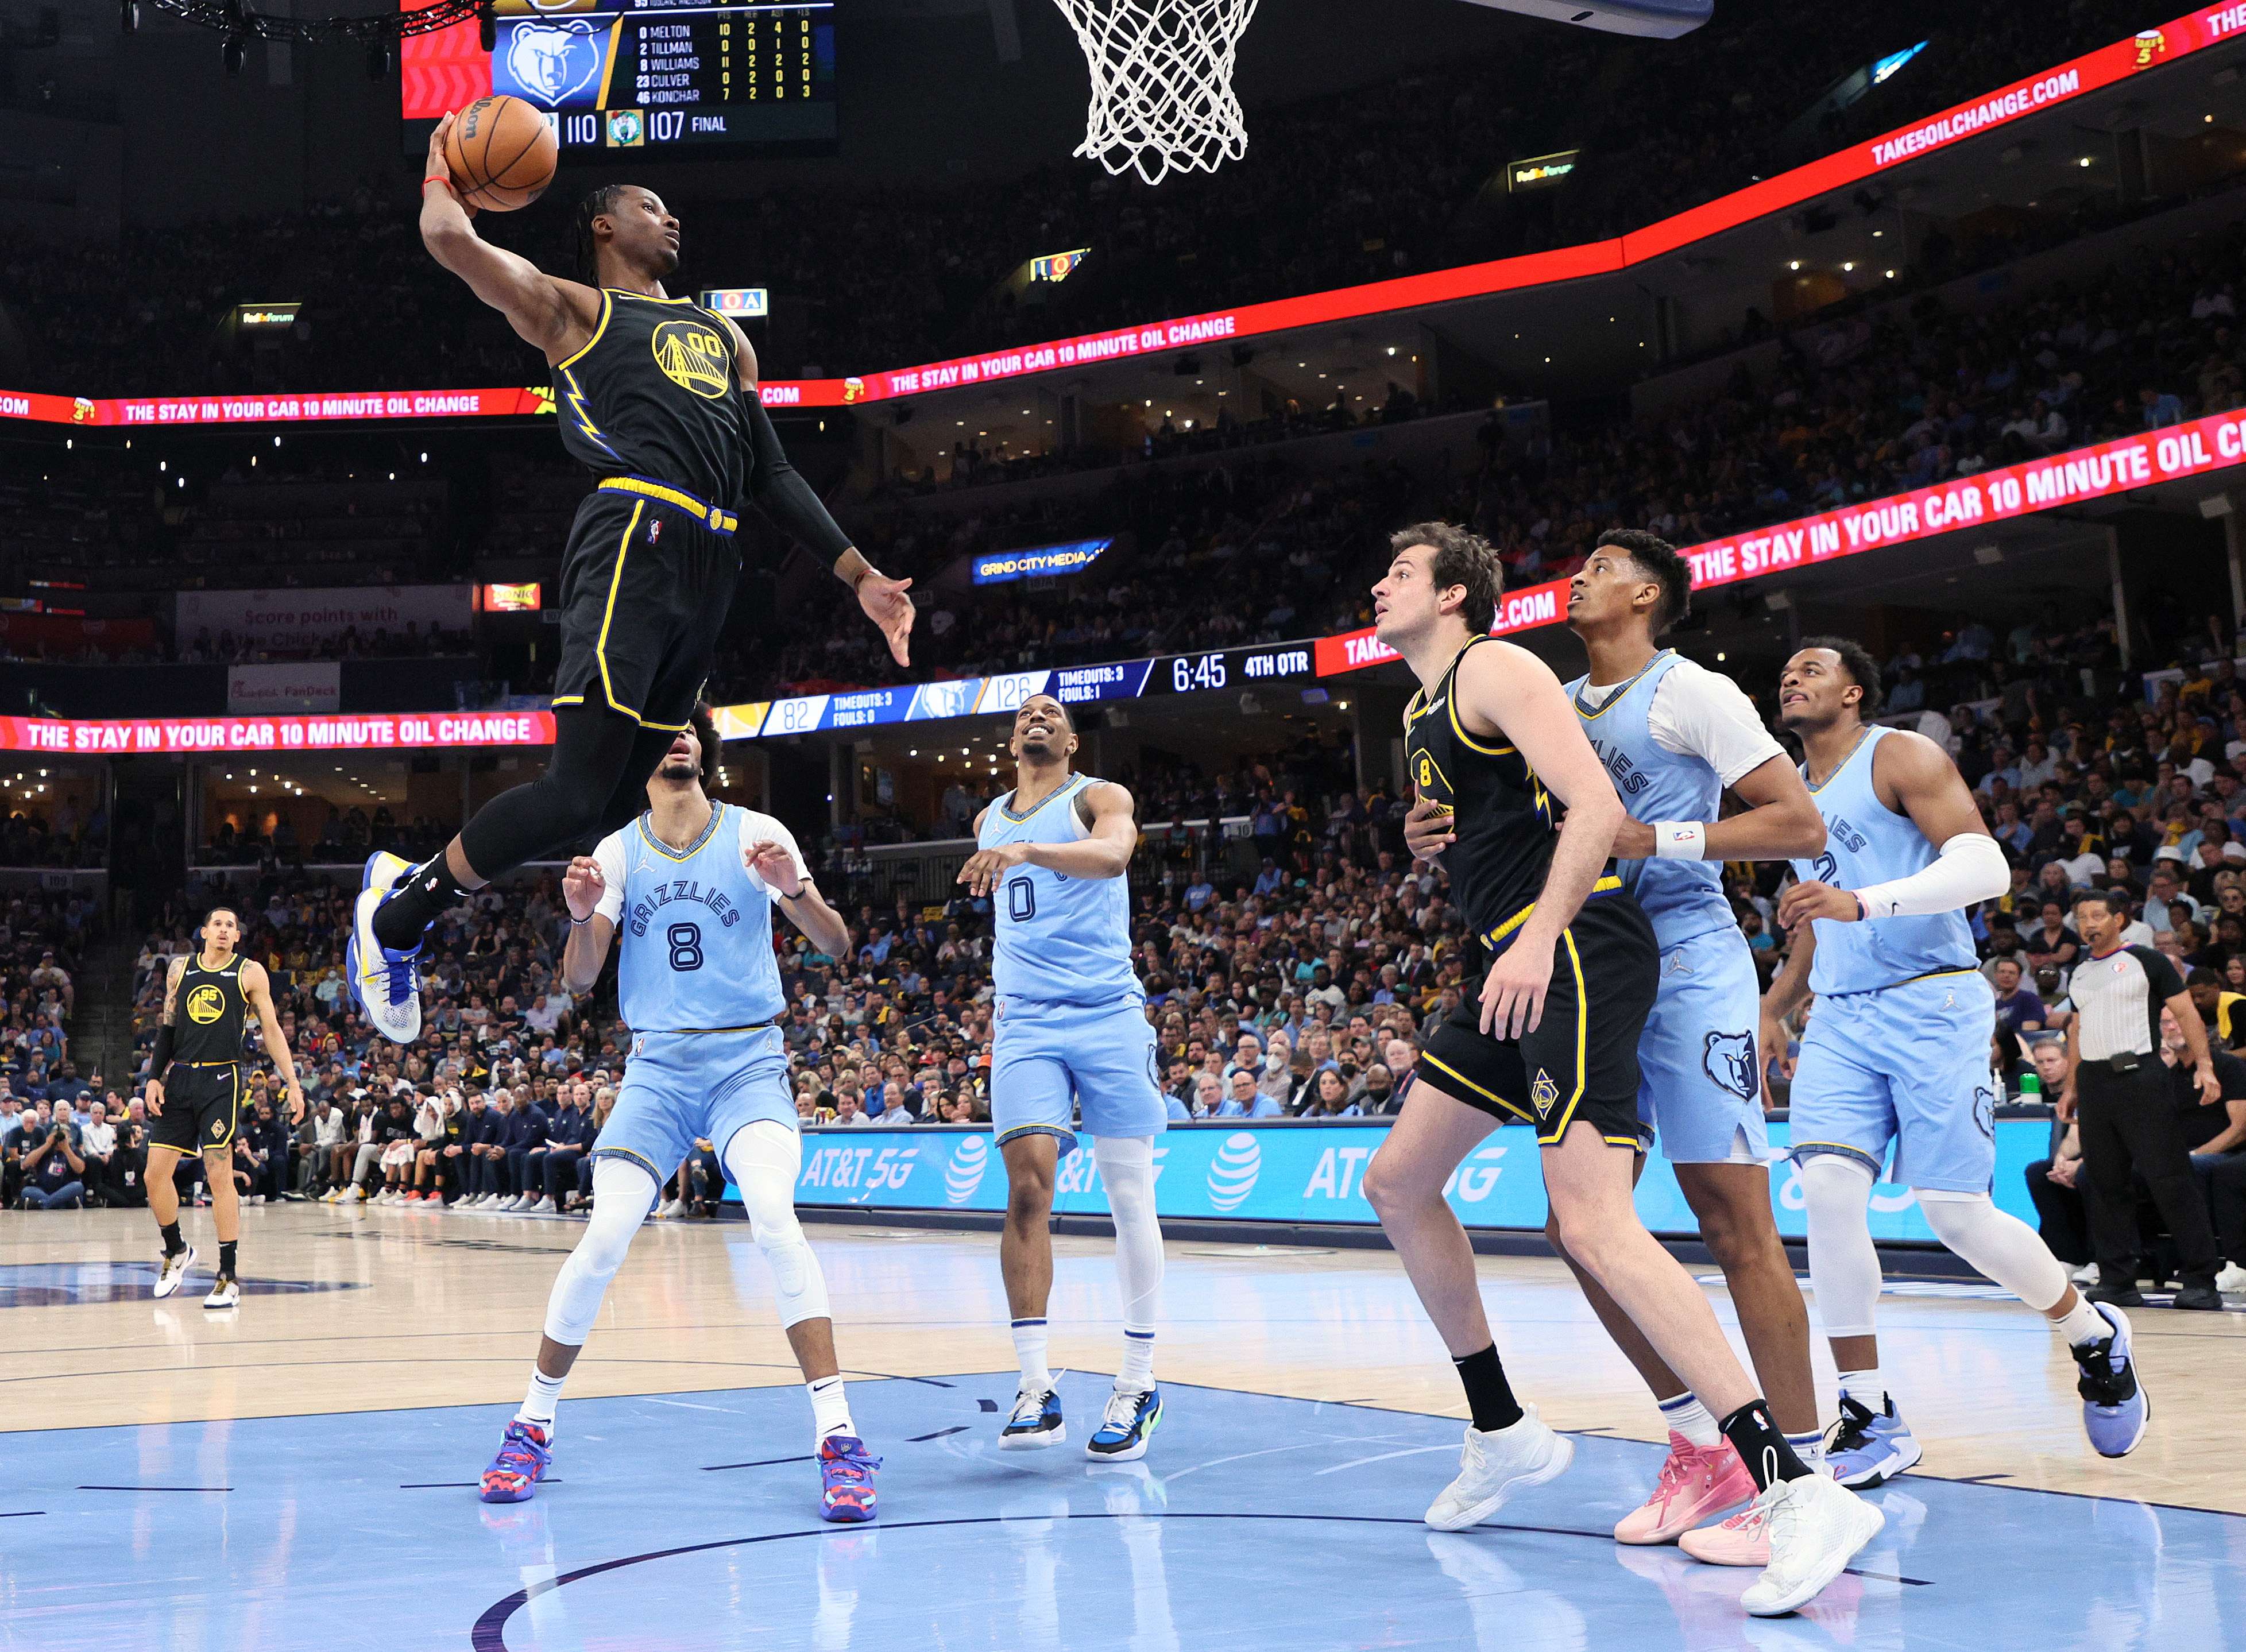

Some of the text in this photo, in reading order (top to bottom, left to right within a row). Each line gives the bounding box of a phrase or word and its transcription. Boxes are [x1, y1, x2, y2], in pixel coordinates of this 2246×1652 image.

[639, 20, 809, 39] 0 MELTON 10 2 4 0
[2207, 3, 2246, 36] THE
[640, 42, 647, 55] 2
[651, 41, 693, 54] TILLMAN
[721, 40, 729, 52] 0
[748, 38, 756, 51] 0
[802, 36, 809, 49] 0
[640, 59, 648, 71] 8
[651, 57, 699, 71] WILLIAMS
[748, 55, 756, 67] 2
[775, 53, 782, 66] 2
[802, 52, 809, 65] 2
[636, 69, 810, 88] 23 CULVER 0 2 0 0
[636, 85, 810, 103] 46 KONCHAR 7 2 0 3
[567, 111, 726, 143] 110 107 FINAL
[1872, 68, 2078, 165] TAKE5OILCHANGE.COM
[710, 293, 761, 309] IOA
[687, 332, 721, 358] 00
[892, 316, 1234, 392] THE STAY IN YOUR CAR 10 MINUTE OIL CHANGE
[126, 396, 478, 420] THE STAY IN YOUR CAR 10 MINUTE OIL CHANGE
[1690, 547, 1736, 582] THE
[1741, 529, 1803, 571] STAY
[1810, 521, 1839, 555] IN
[1843, 503, 1918, 545] YOUR
[1925, 487, 1982, 527] CAR
[1989, 478, 2020, 511] 10
[2026, 446, 2150, 503] MINUTE
[2158, 432, 2211, 471] OIL
[980, 551, 1087, 576] GRIND CITY MEDIA
[245, 607, 397, 625] Score points with
[1058, 666, 1123, 687] TIMEOUTS: 3
[1173, 651, 1308, 692] 6:45 4TH QTR
[833, 692, 892, 710] TIMEOUTS: 3
[995, 677, 1030, 711] 126
[1058, 686, 1092, 703] FOULS:
[783, 702, 808, 730] 82
[833, 710, 875, 727] FOULS: 0
[28, 718, 530, 748] THE STAY IN YOUR CAR 10 MINUTE OIL CHANGE
[1420, 758, 1431, 787] 8
[630, 880, 740, 937] GRIZZLIES
[1008, 876, 1036, 923] 0
[667, 922, 703, 972] 8
[200, 989, 218, 1001] 95
[802, 1148, 919, 1189] AT&T 5G
